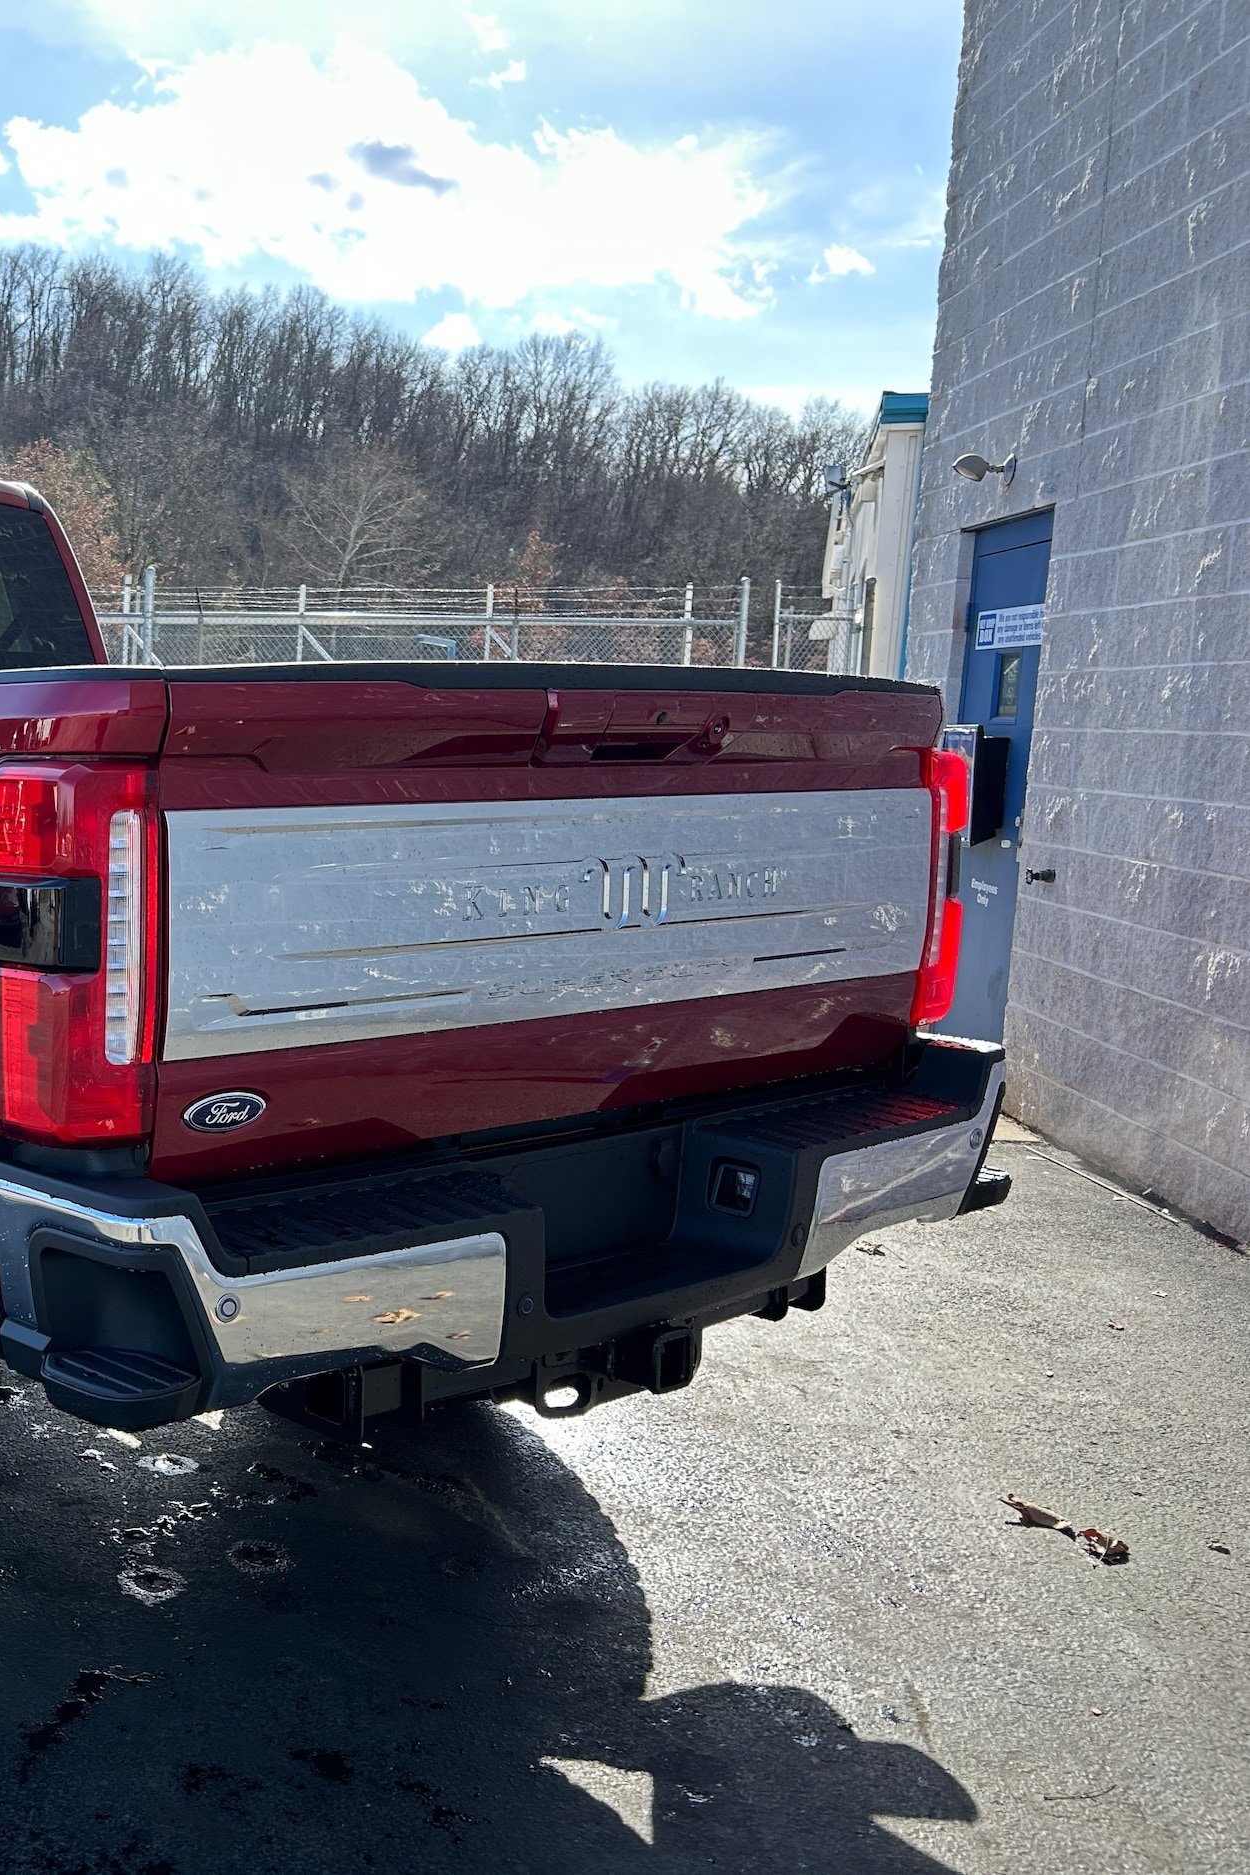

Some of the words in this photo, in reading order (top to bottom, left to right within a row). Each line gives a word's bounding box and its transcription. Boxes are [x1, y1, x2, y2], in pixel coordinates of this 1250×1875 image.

[462, 883, 570, 922] KING
[688, 865, 780, 902] RANCH
[971, 878, 998, 895] Employees
[977, 892, 989, 908] Only
[487, 968, 633, 999] SUPER
[644, 958, 733, 982] DUTY
[205, 1101, 251, 1125] Ford
